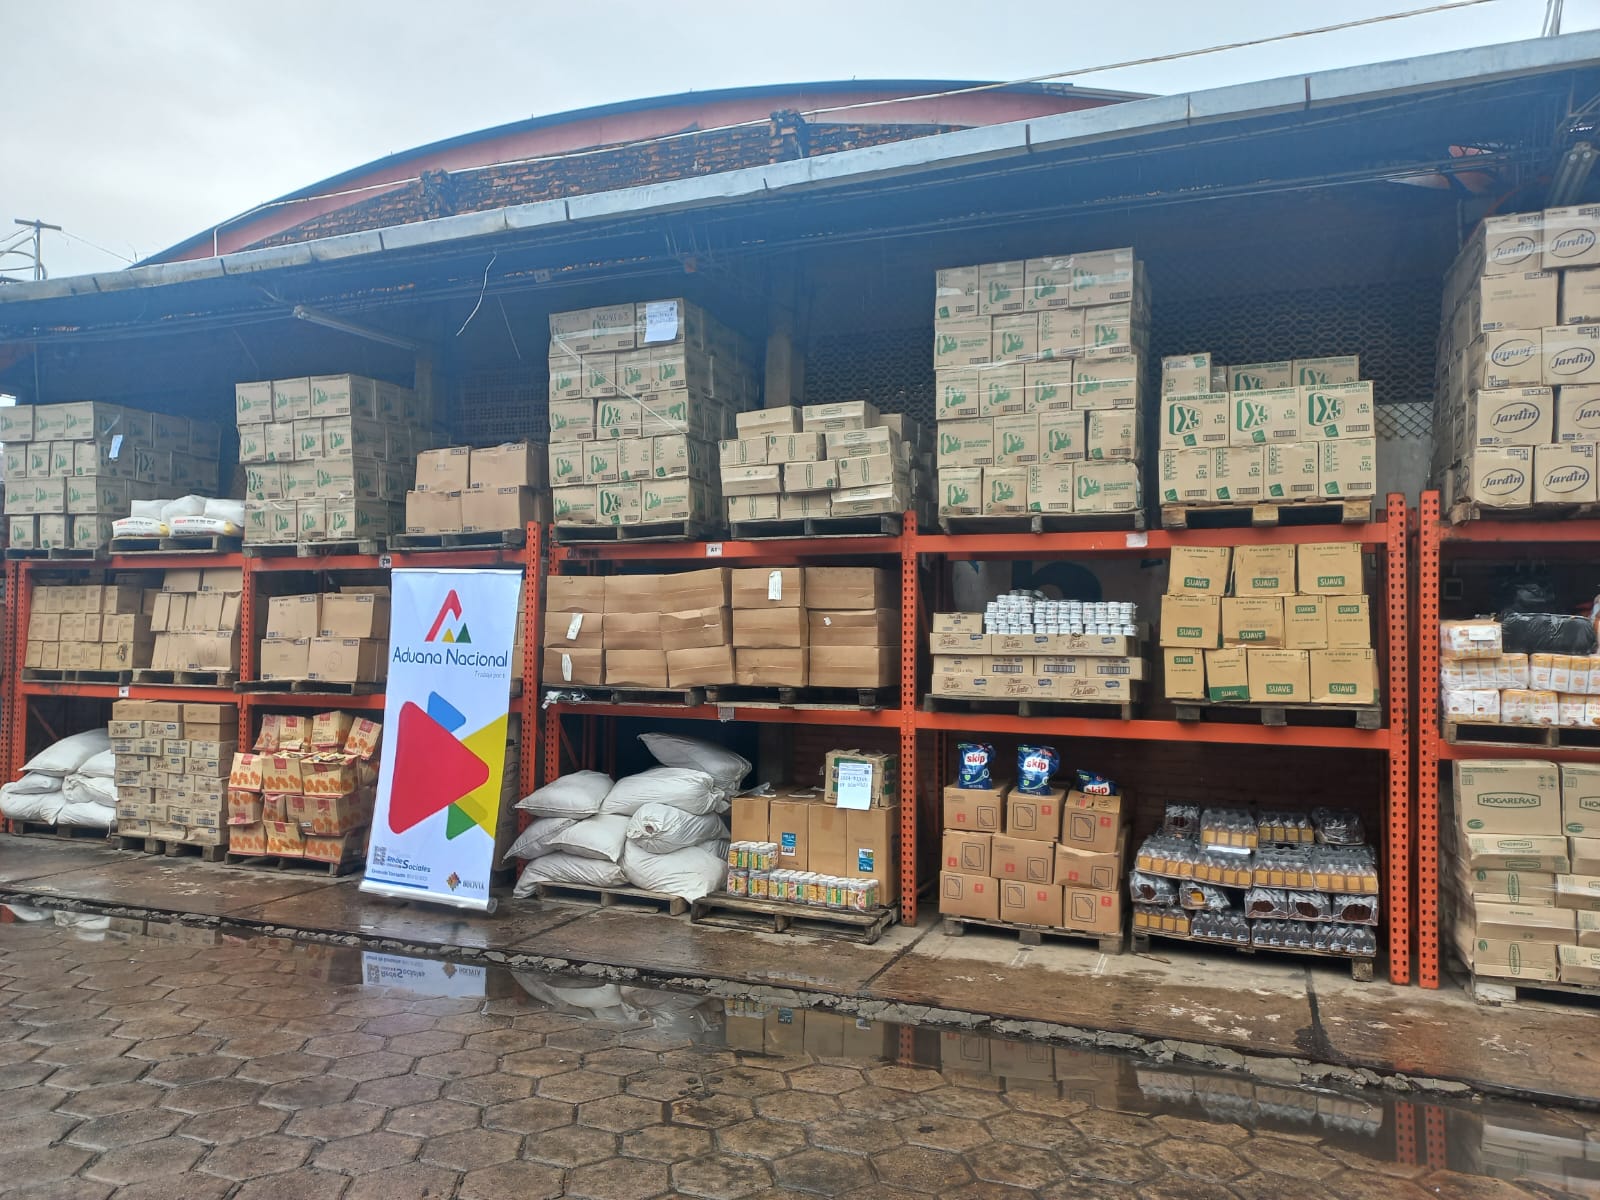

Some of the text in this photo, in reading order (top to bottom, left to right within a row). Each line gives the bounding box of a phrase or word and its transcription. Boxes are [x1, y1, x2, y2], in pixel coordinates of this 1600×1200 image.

[1186, 578, 1208, 588] SUAVE
[1254, 579, 1277, 588] SUAVE
[1320, 578, 1343, 586] SUAVE
[1179, 628, 1201, 637] SUAVE
[1241, 632, 1264, 640] SUAVE
[393, 646, 508, 667] Aduana Nacional
[1269, 685, 1291, 693] SUAVE
[1331, 684, 1355, 693] SUAVE
[967, 754, 985, 764] skip
[1026, 760, 1047, 770] skip
[1482, 796, 1537, 804] HOGAREÑAS
[462, 880, 485, 890] BOLIVIA
